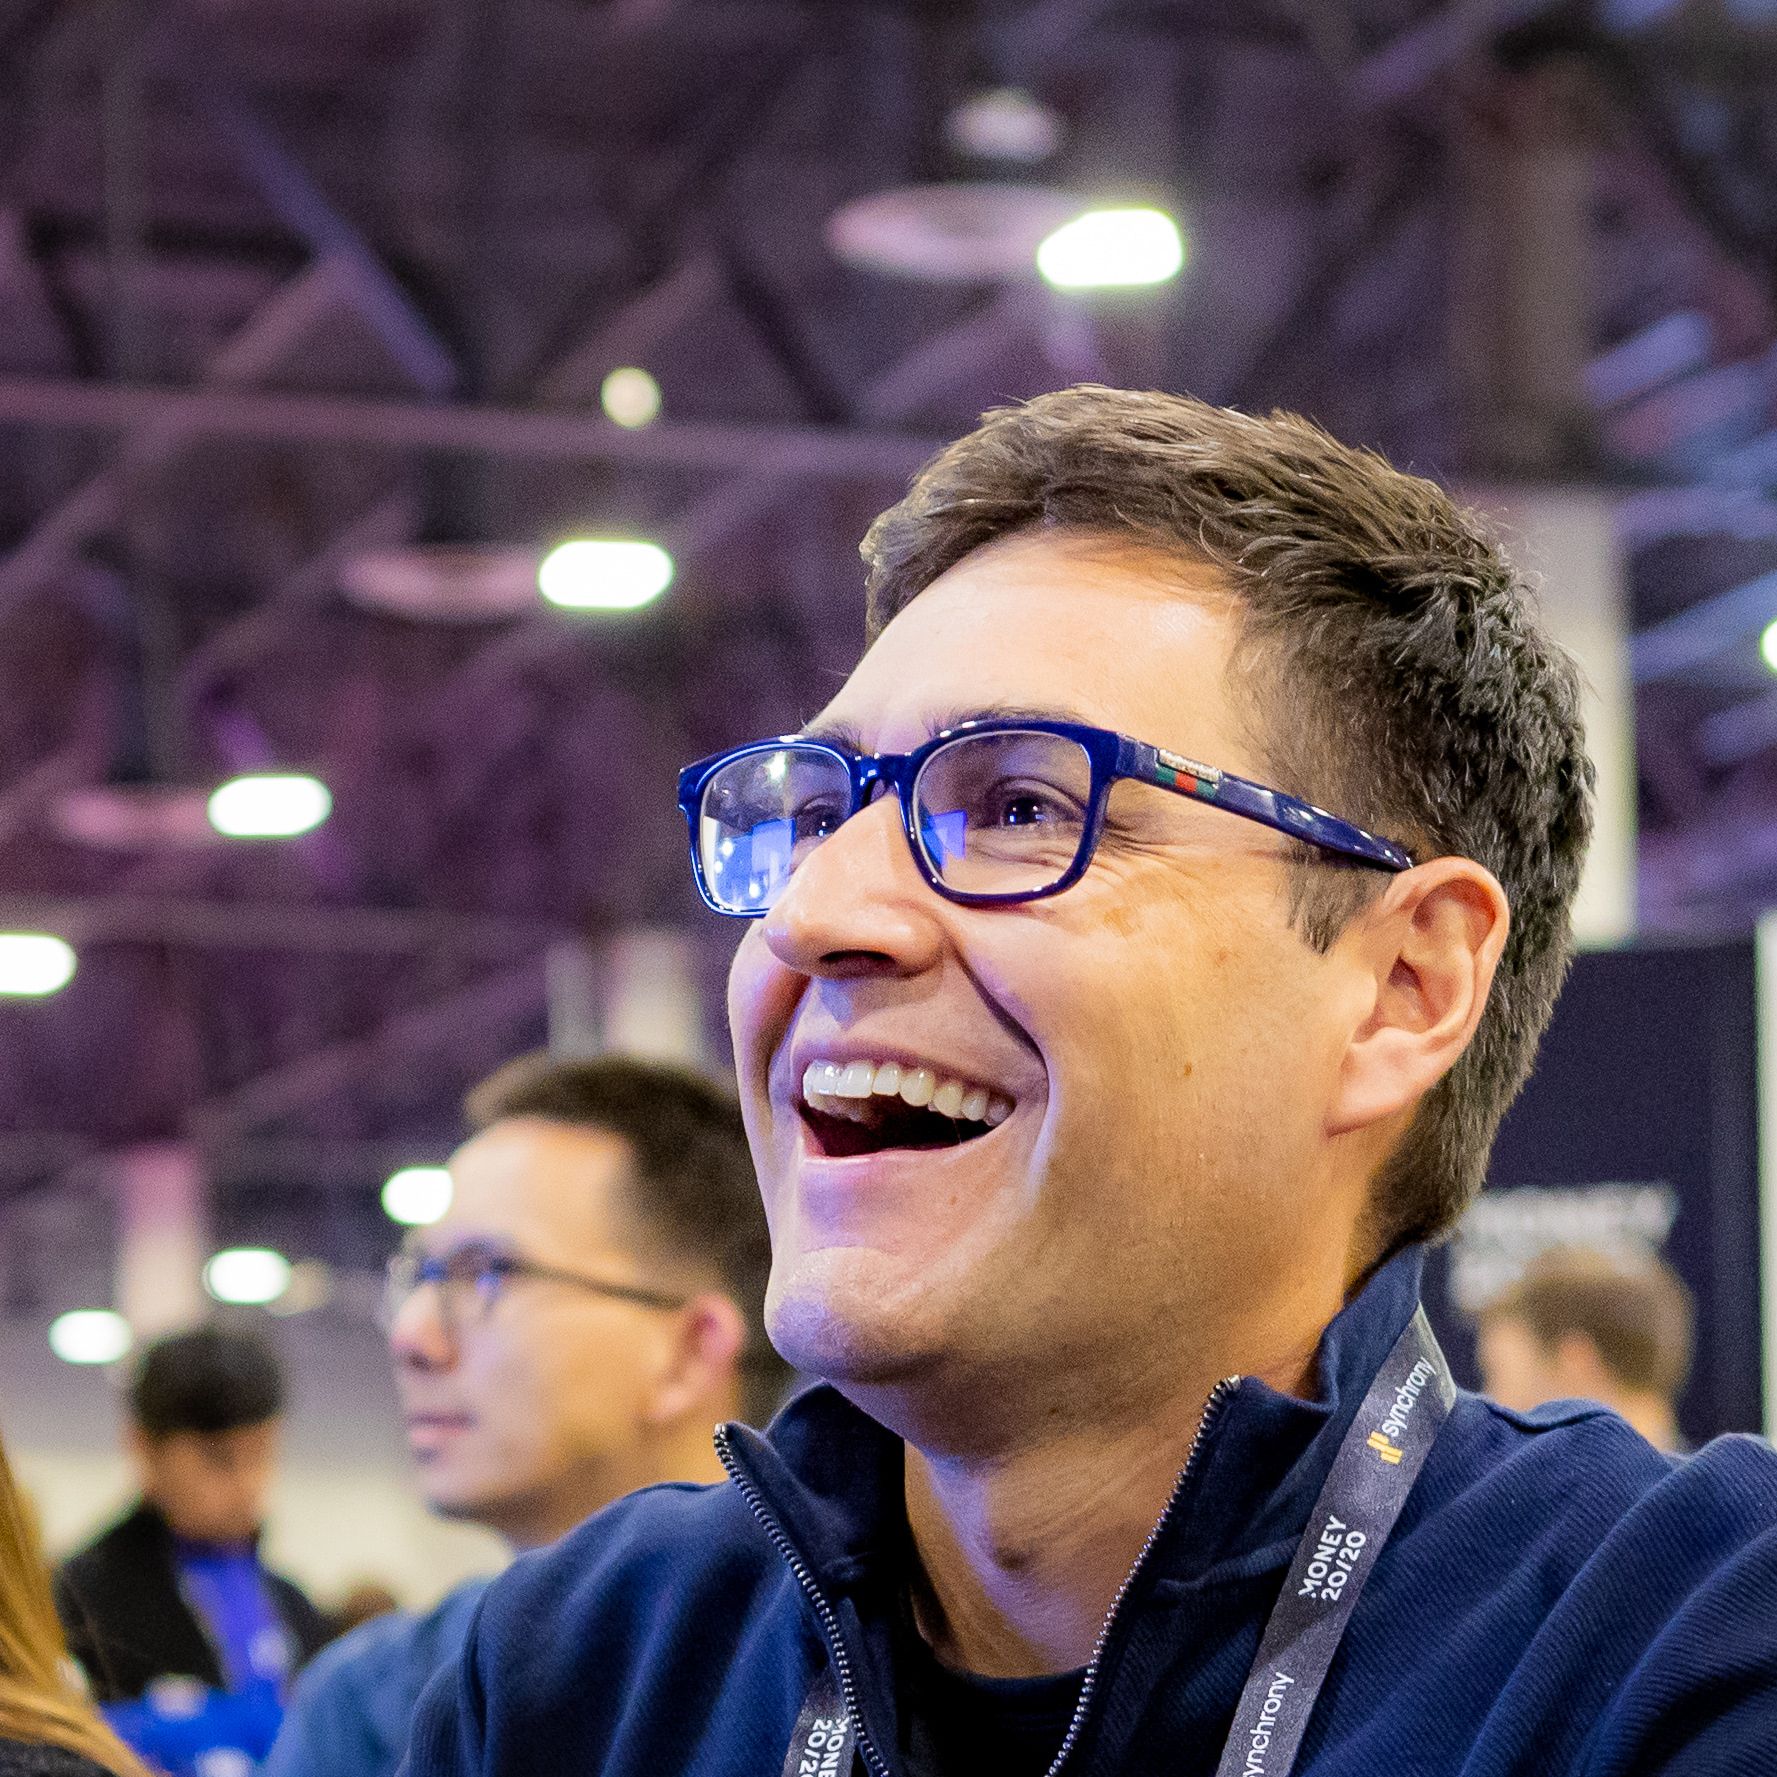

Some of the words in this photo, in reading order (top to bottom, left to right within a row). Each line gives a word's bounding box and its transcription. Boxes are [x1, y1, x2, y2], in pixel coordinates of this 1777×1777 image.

[1382, 1356, 1437, 1437] synchrony
[1298, 1514, 1346, 1598] MONEY
[1321, 1531, 1366, 1601] 20/20
